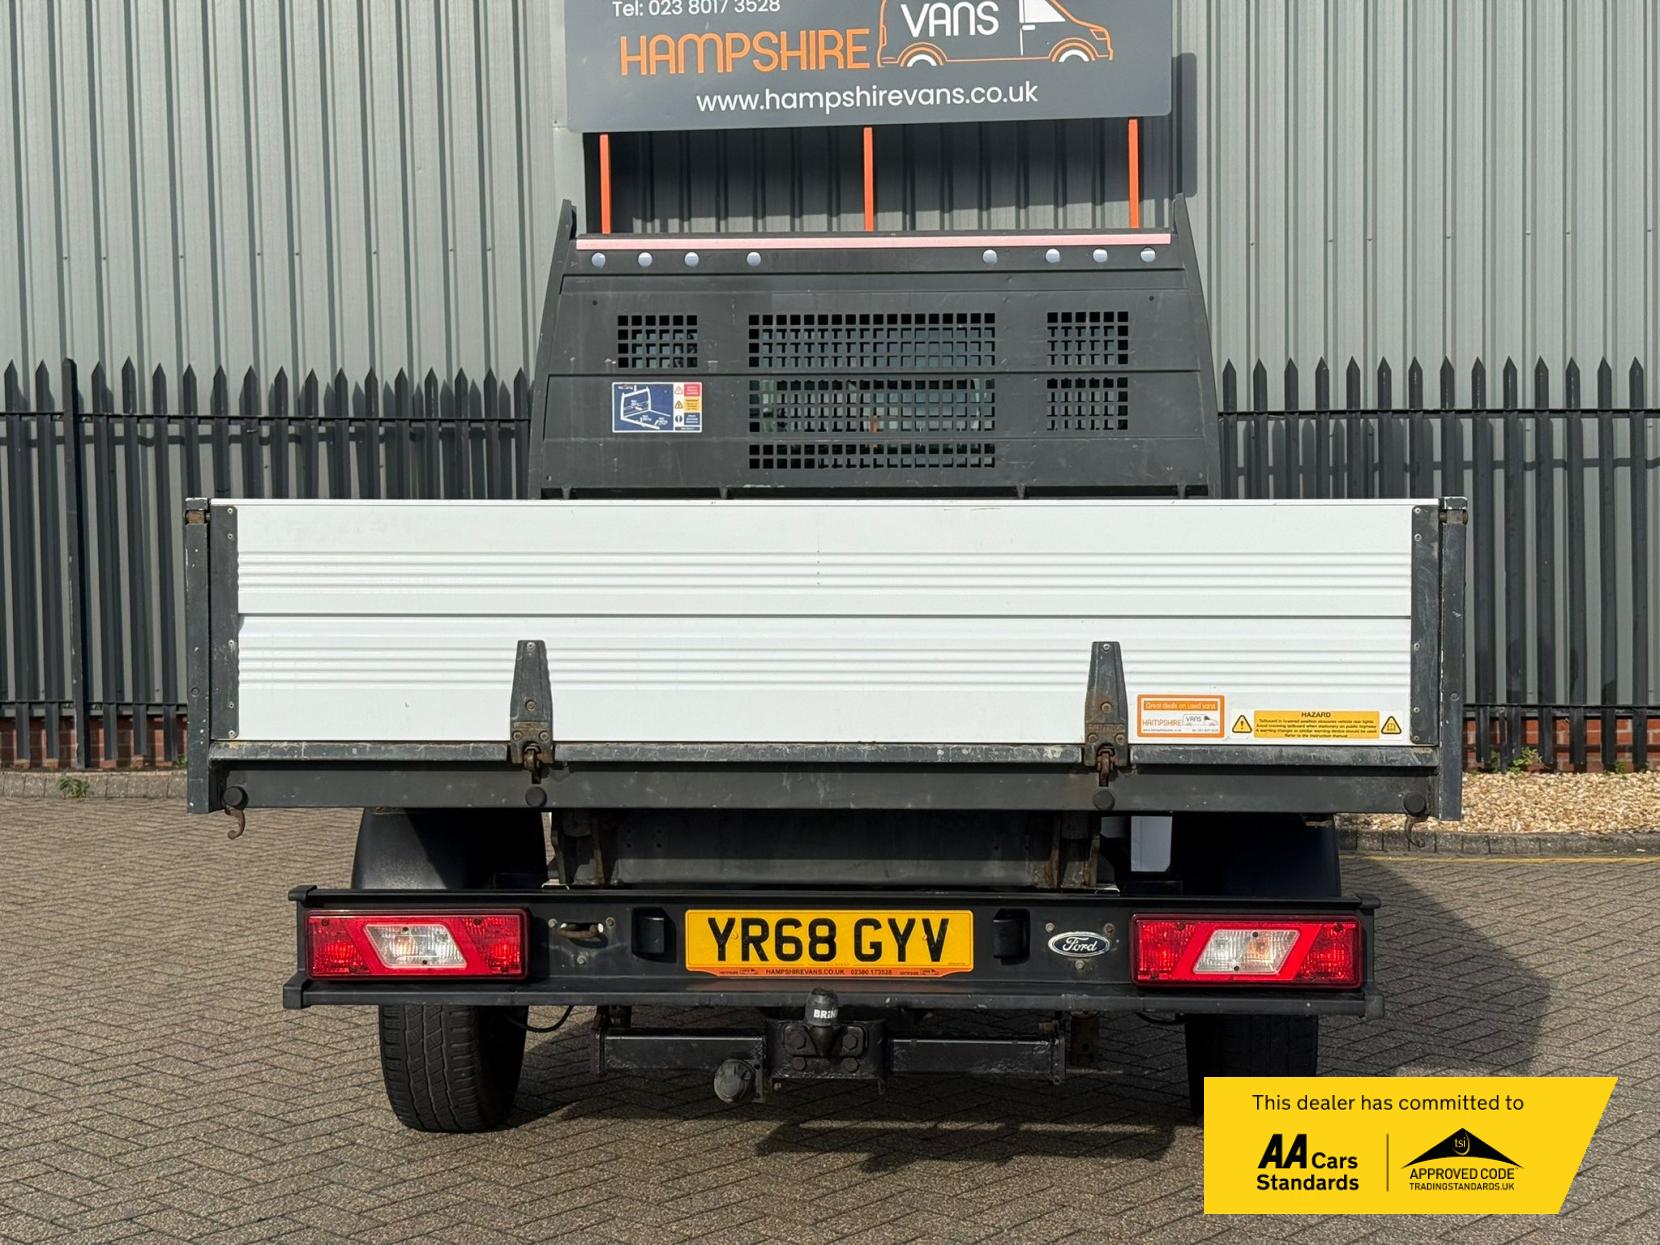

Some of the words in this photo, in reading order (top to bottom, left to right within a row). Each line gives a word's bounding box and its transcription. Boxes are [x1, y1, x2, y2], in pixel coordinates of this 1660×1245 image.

[612, 1, 643, 17] Tel:
[649, 0, 683, 16] 023
[688, 0, 727, 15] 8017
[734, 0, 781, 13] 3528
[620, 28, 870, 76] HAMPSHIRE
[900, 0, 1000, 38] VANS
[696, 81, 1039, 115] www.hampshirevans.co.uk
[707, 917, 837, 962] YR68
[853, 918, 950, 962] GYV
[1062, 936, 1098, 952] Ford
